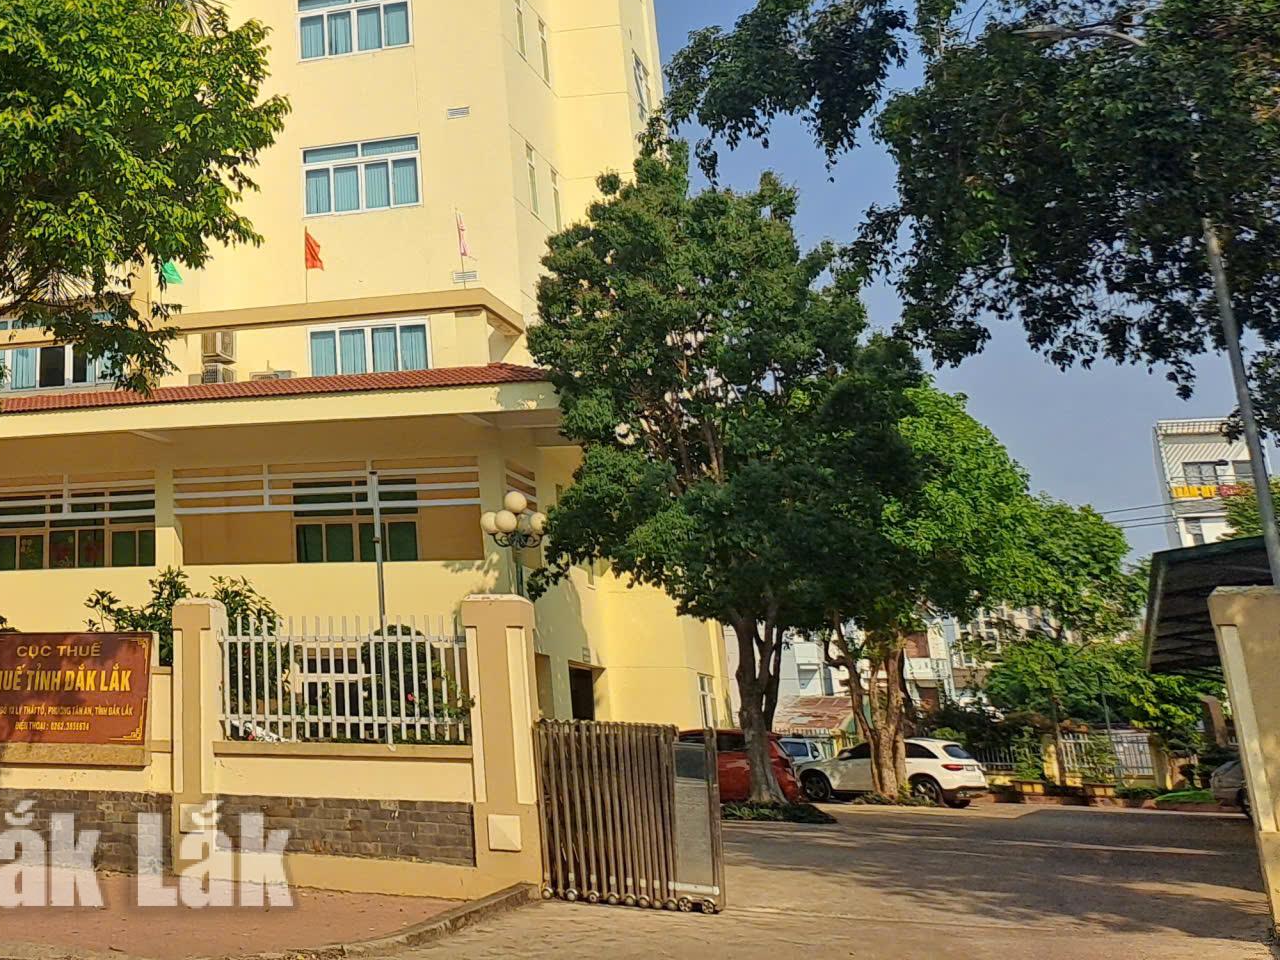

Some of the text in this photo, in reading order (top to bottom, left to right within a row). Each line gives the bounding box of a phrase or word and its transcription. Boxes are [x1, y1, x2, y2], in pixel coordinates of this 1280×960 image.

[16, 641, 103, 659] CỤC THUẾ
[26, 662, 62, 691] TỈNH
[63, 663, 98, 691] ĐẮK
[99, 662, 132, 692] LẮK
